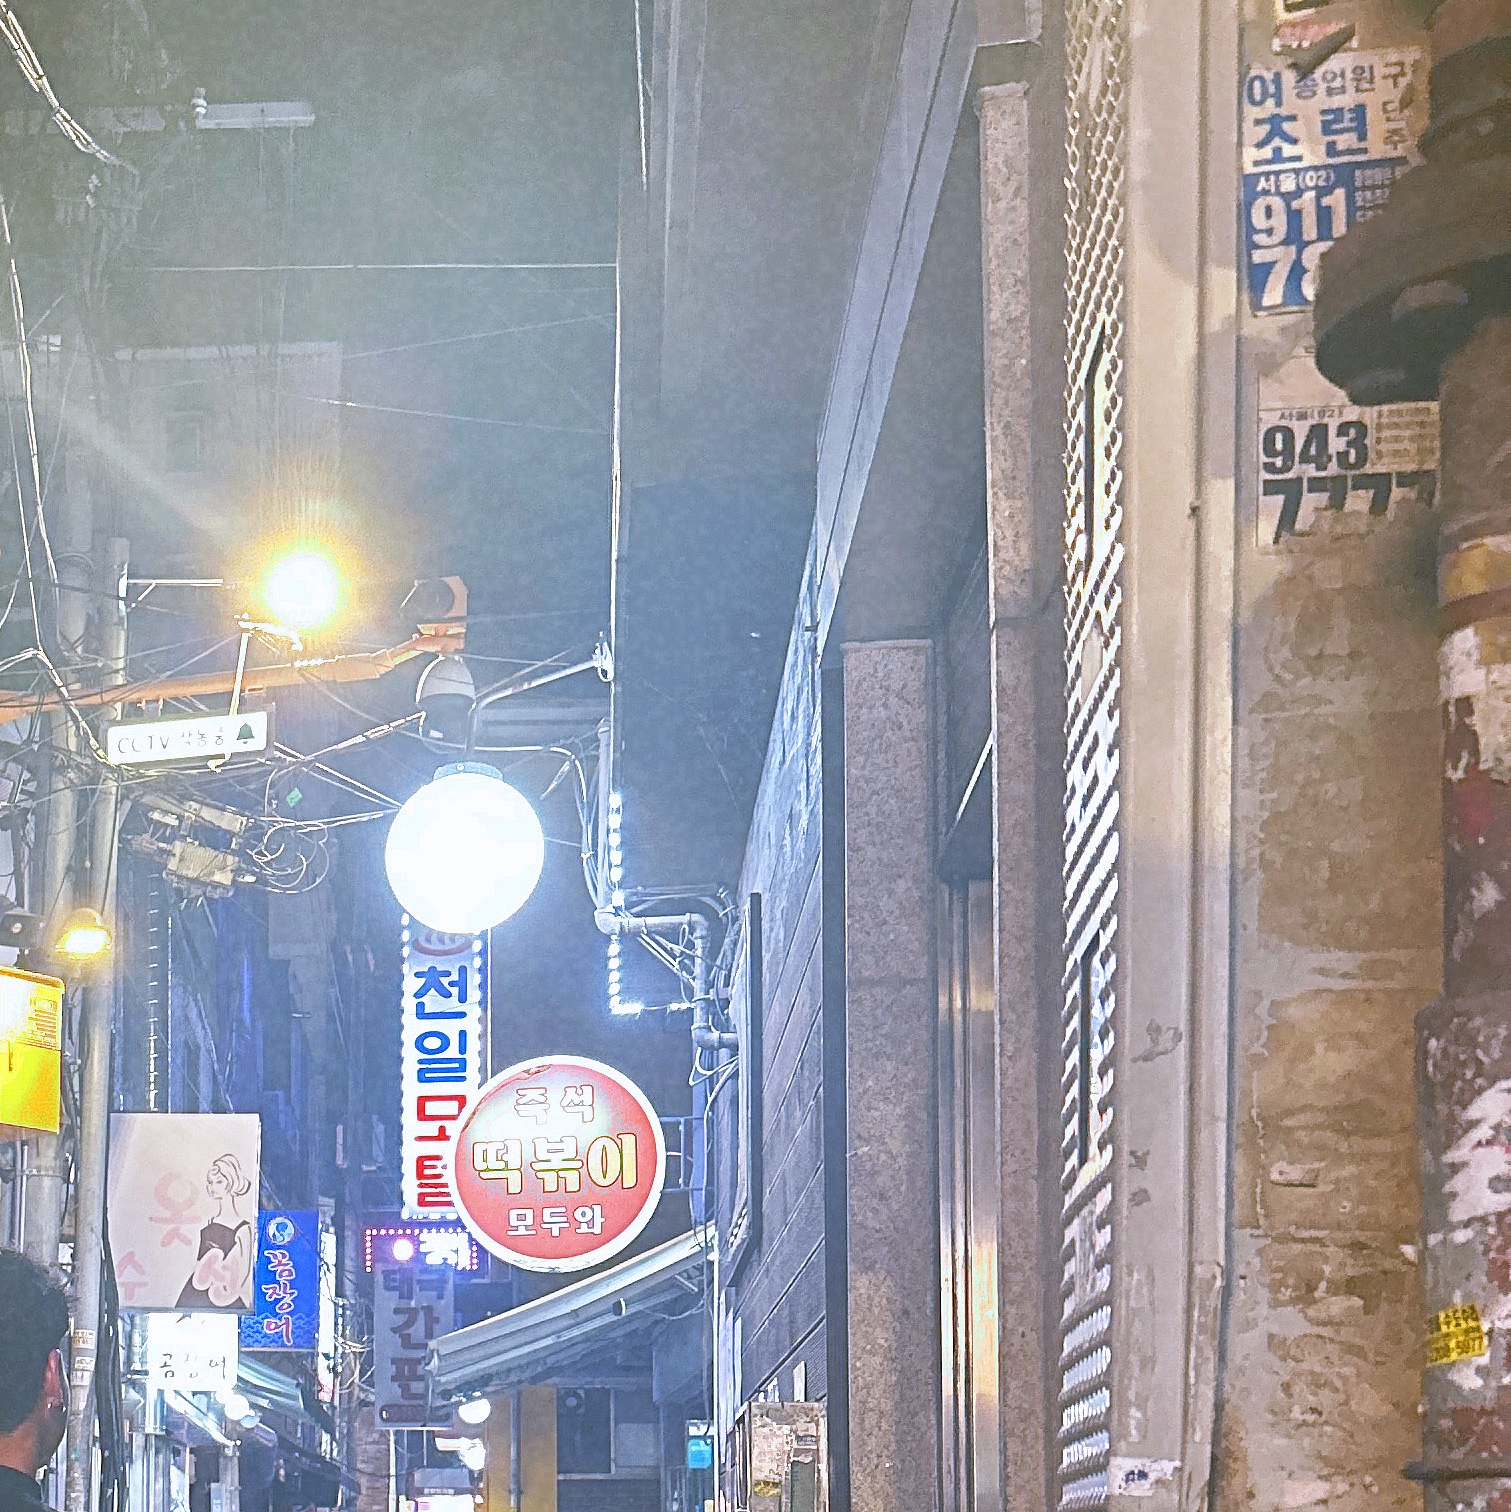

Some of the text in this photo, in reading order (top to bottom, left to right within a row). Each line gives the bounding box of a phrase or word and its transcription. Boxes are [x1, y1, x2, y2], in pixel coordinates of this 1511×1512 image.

[1246, 72, 1282, 107] 여
[1256, 168, 1336, 194] 서울(02)
[1250, 187, 1348, 247] 911
[1262, 420, 1369, 476] 943
[117, 735, 170, 754] CCTV
[513, 1084, 596, 1125] 즉석
[471, 1131, 640, 1196] 떡볶이
[505, 1203, 606, 1237] 모두와
[261, 1249, 298, 1346] 꼼장어
